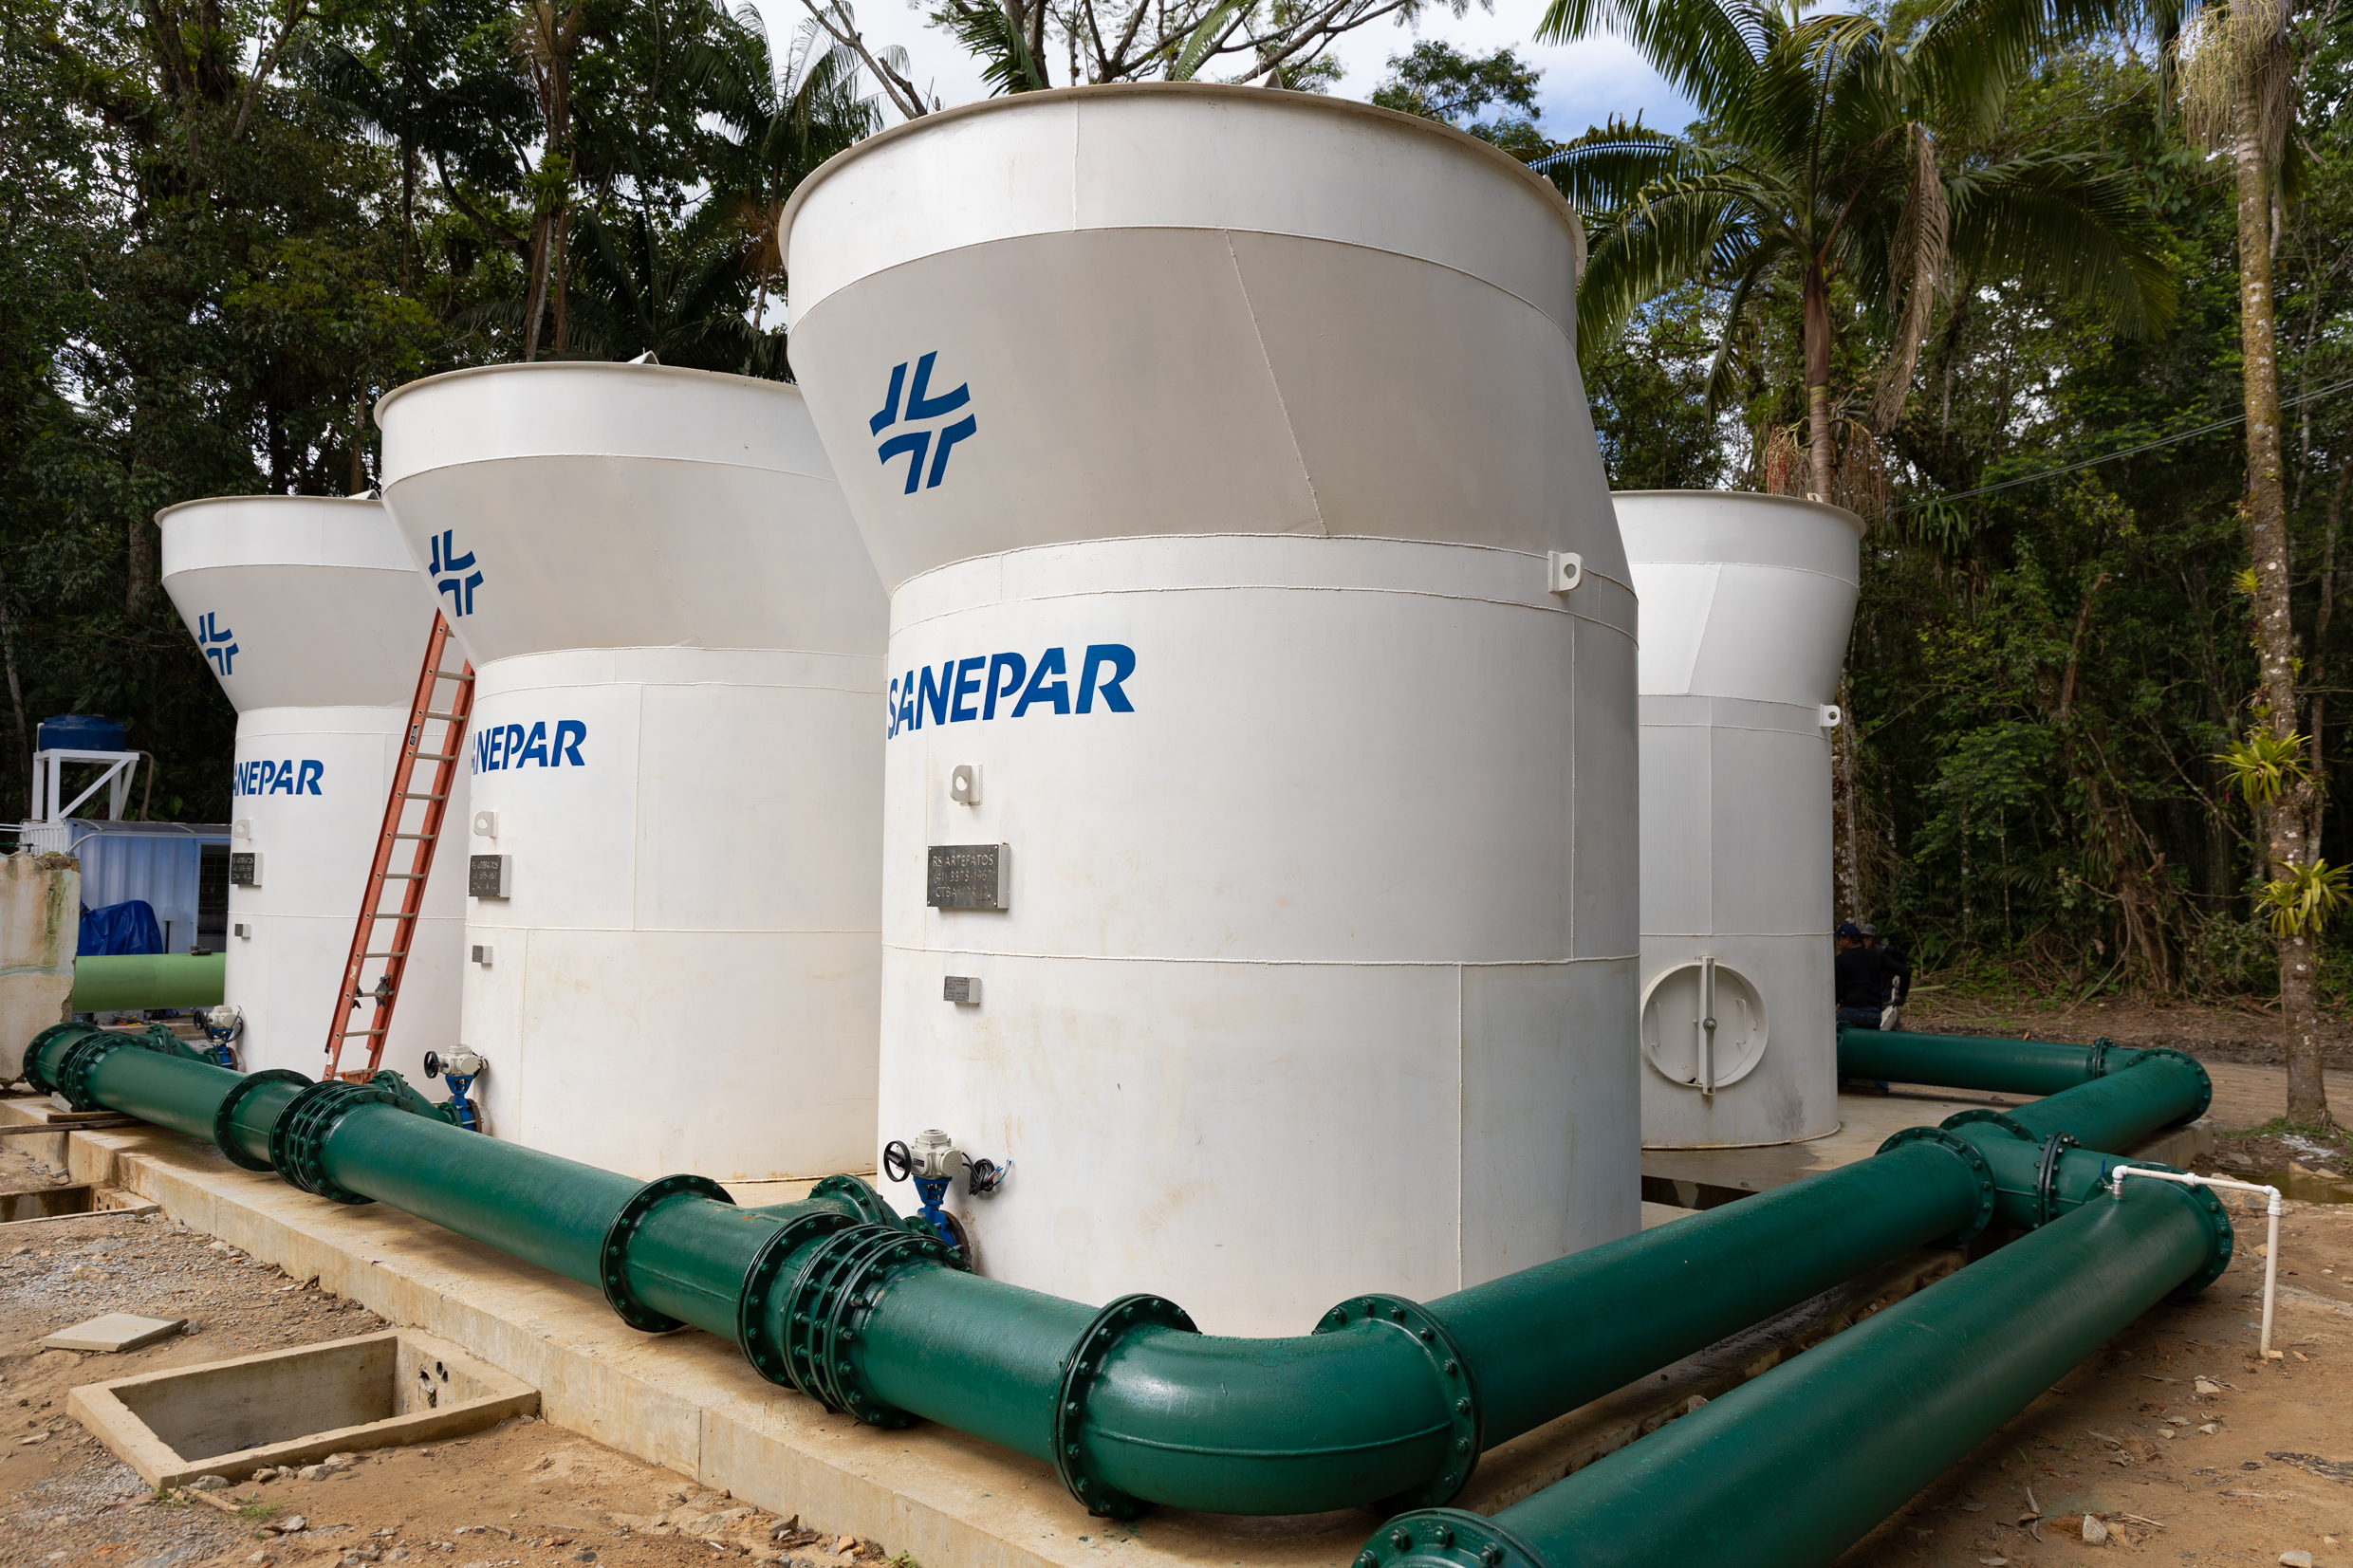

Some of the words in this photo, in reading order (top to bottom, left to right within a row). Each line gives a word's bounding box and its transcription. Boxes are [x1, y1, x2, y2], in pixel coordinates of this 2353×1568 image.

[887, 643, 1137, 740] SANEPAR
[932, 856, 943, 867] RS
[945, 854, 993, 867] ARTEFATOS
